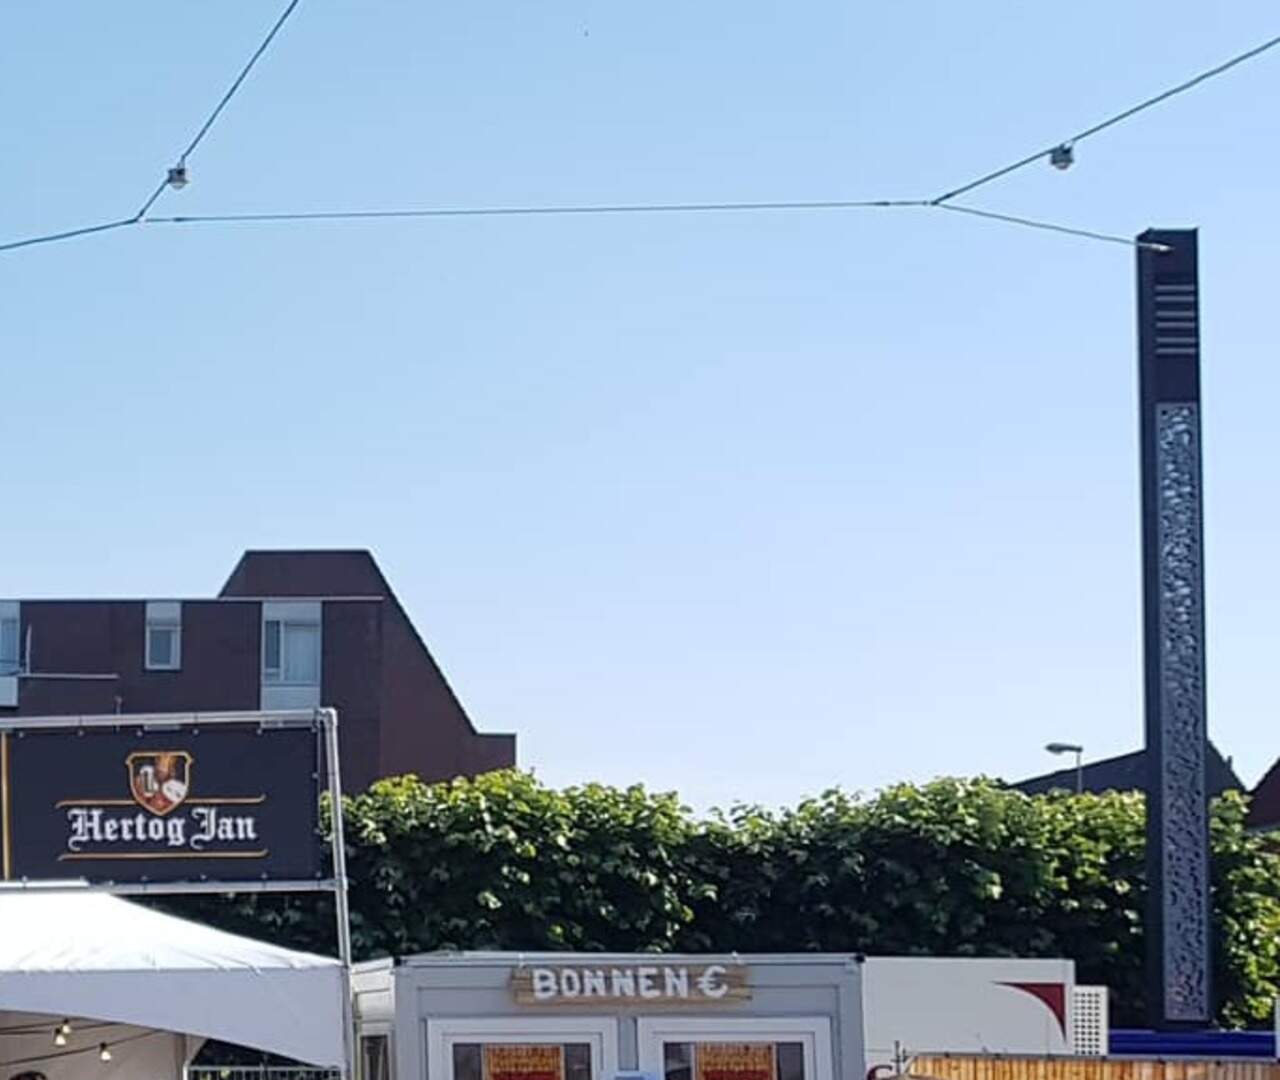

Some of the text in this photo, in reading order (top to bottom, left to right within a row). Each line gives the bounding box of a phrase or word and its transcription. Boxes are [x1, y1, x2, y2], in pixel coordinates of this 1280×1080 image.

[67, 808, 257, 852] Hertog Jan
[532, 965, 729, 999] BONNEN €
